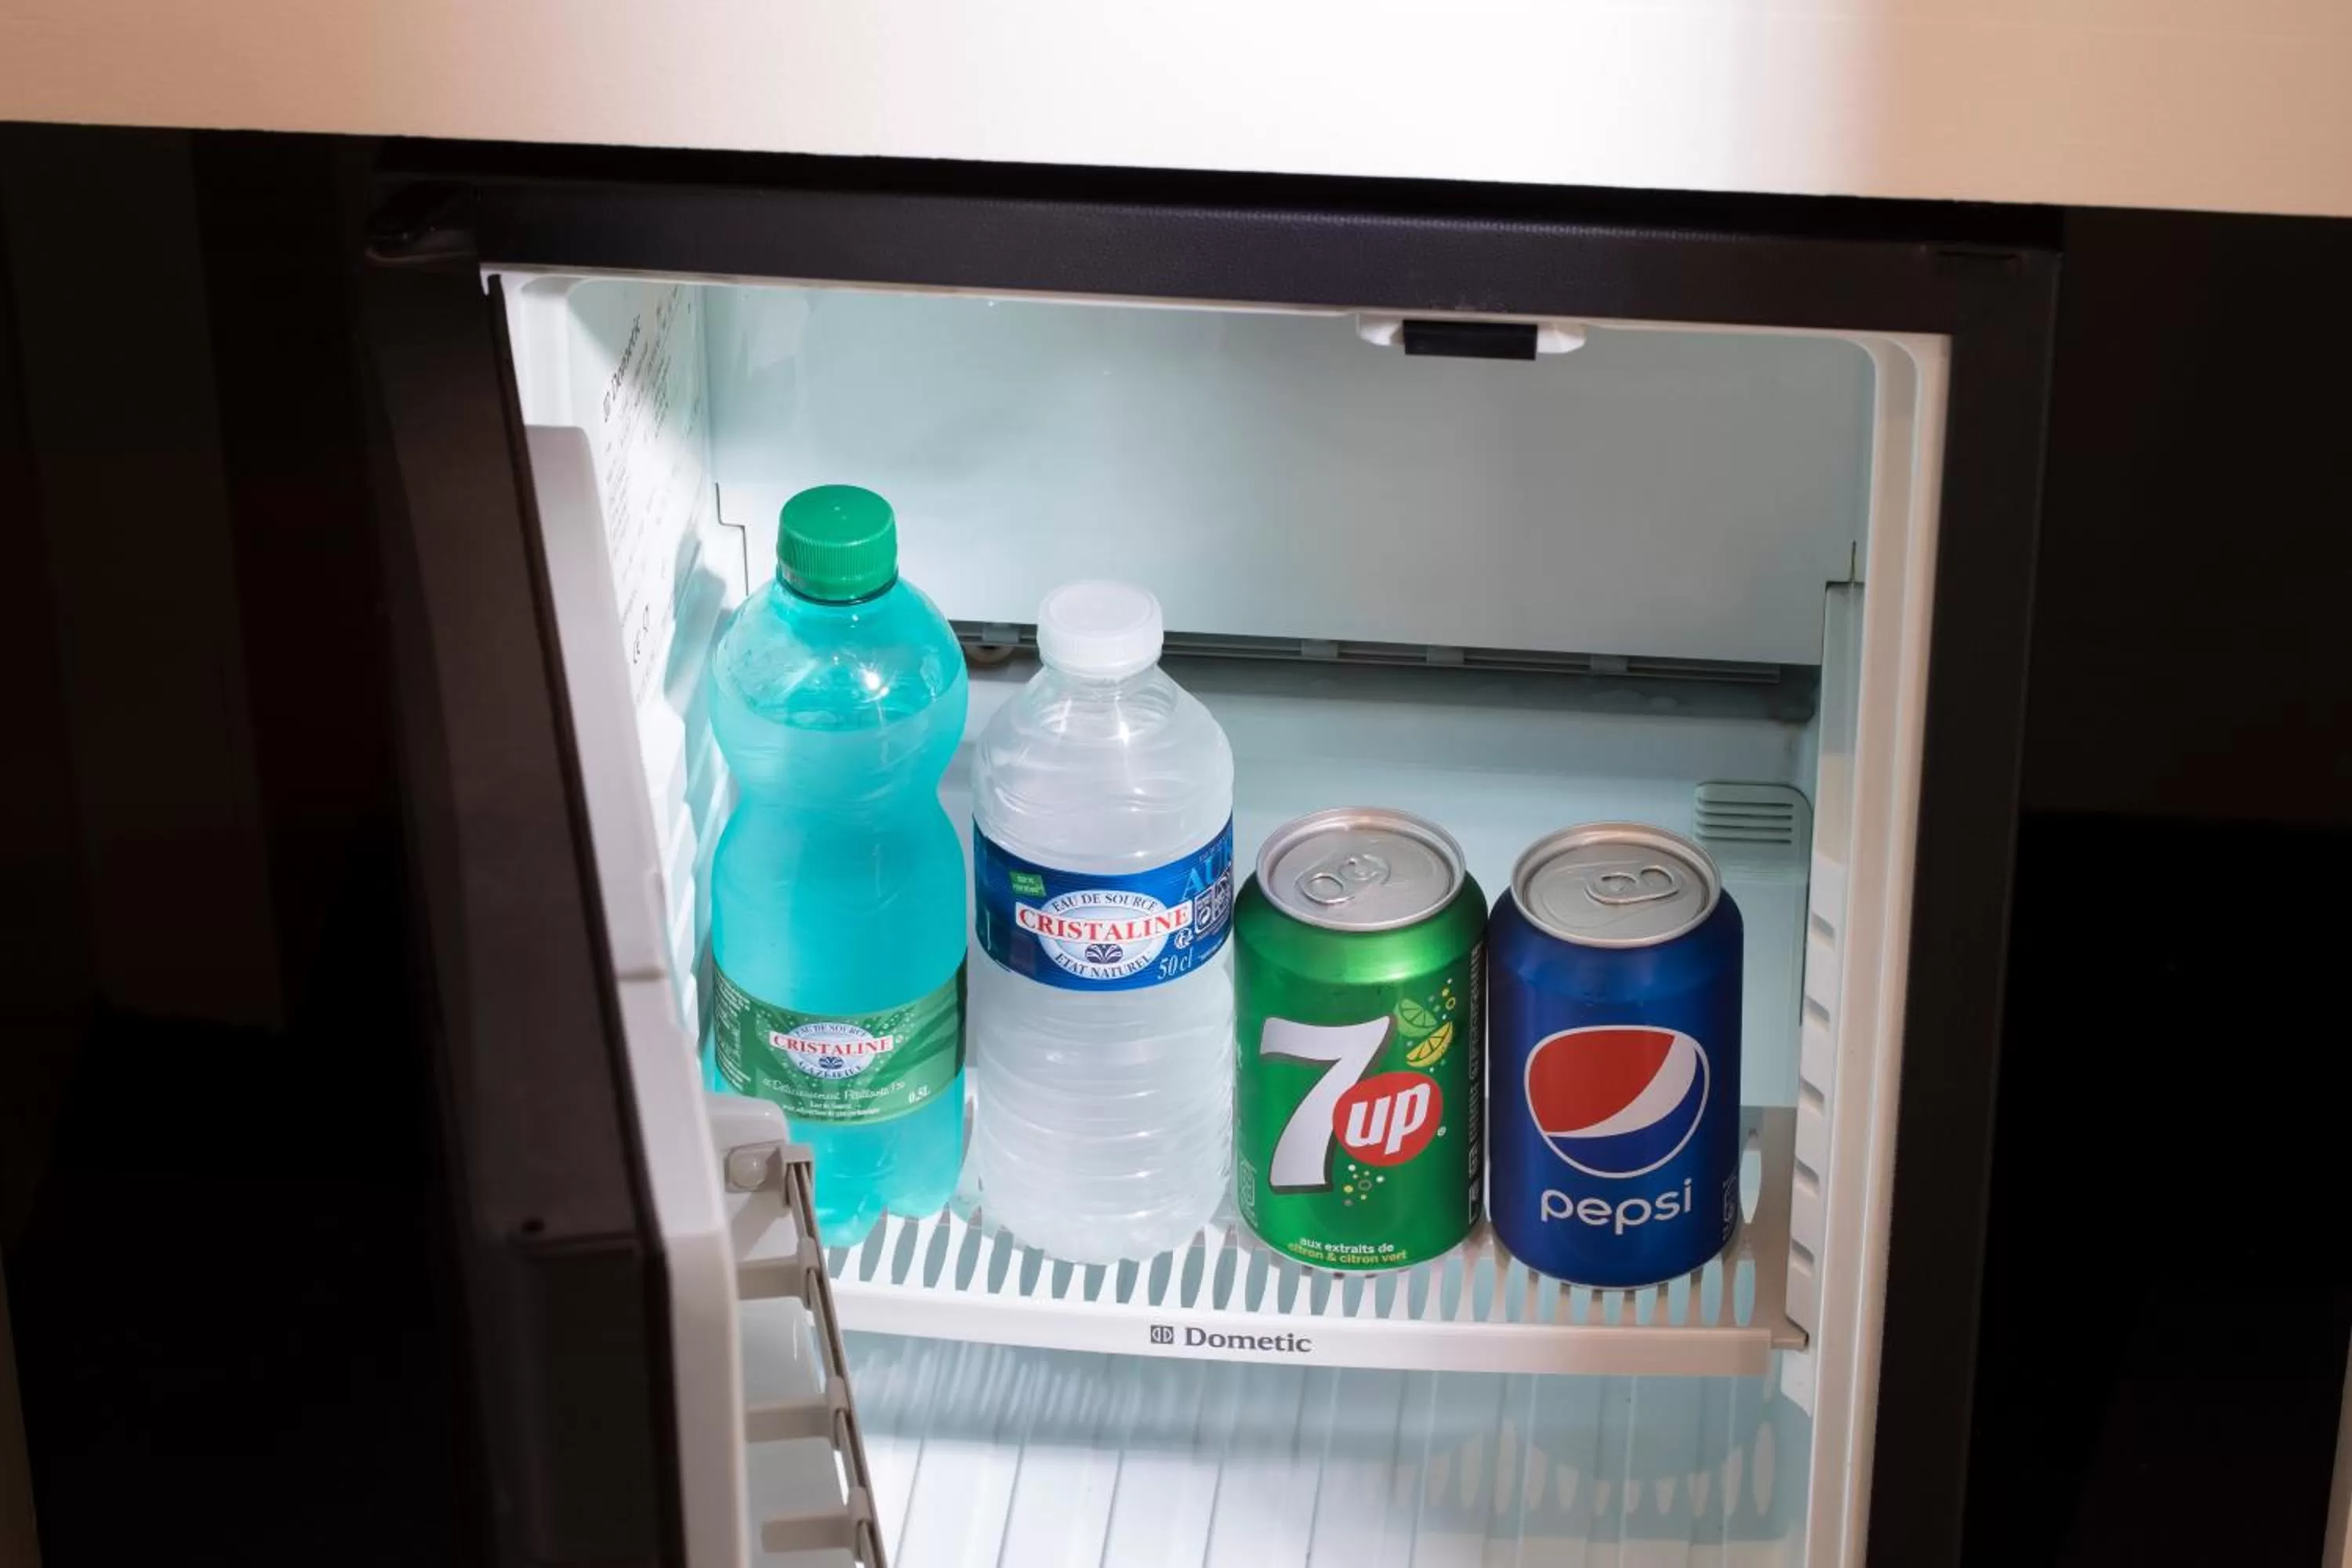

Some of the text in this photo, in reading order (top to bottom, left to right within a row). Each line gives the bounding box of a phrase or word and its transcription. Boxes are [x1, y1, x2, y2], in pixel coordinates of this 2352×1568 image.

[1051, 893, 1158, 911] EAU DE SOURCE
[1018, 904, 1190, 942] CRISTALINE
[1055, 953, 1153, 978] ETAT NATUREL
[773, 1034, 891, 1055] CRISTALINE
[1541, 1178, 1693, 1236] pepsi
[1287, 1243, 1408, 1264] citron & citron vert
[1299, 1237, 1394, 1254] aux extraits de
[1185, 1327, 1312, 1352] Dometic
